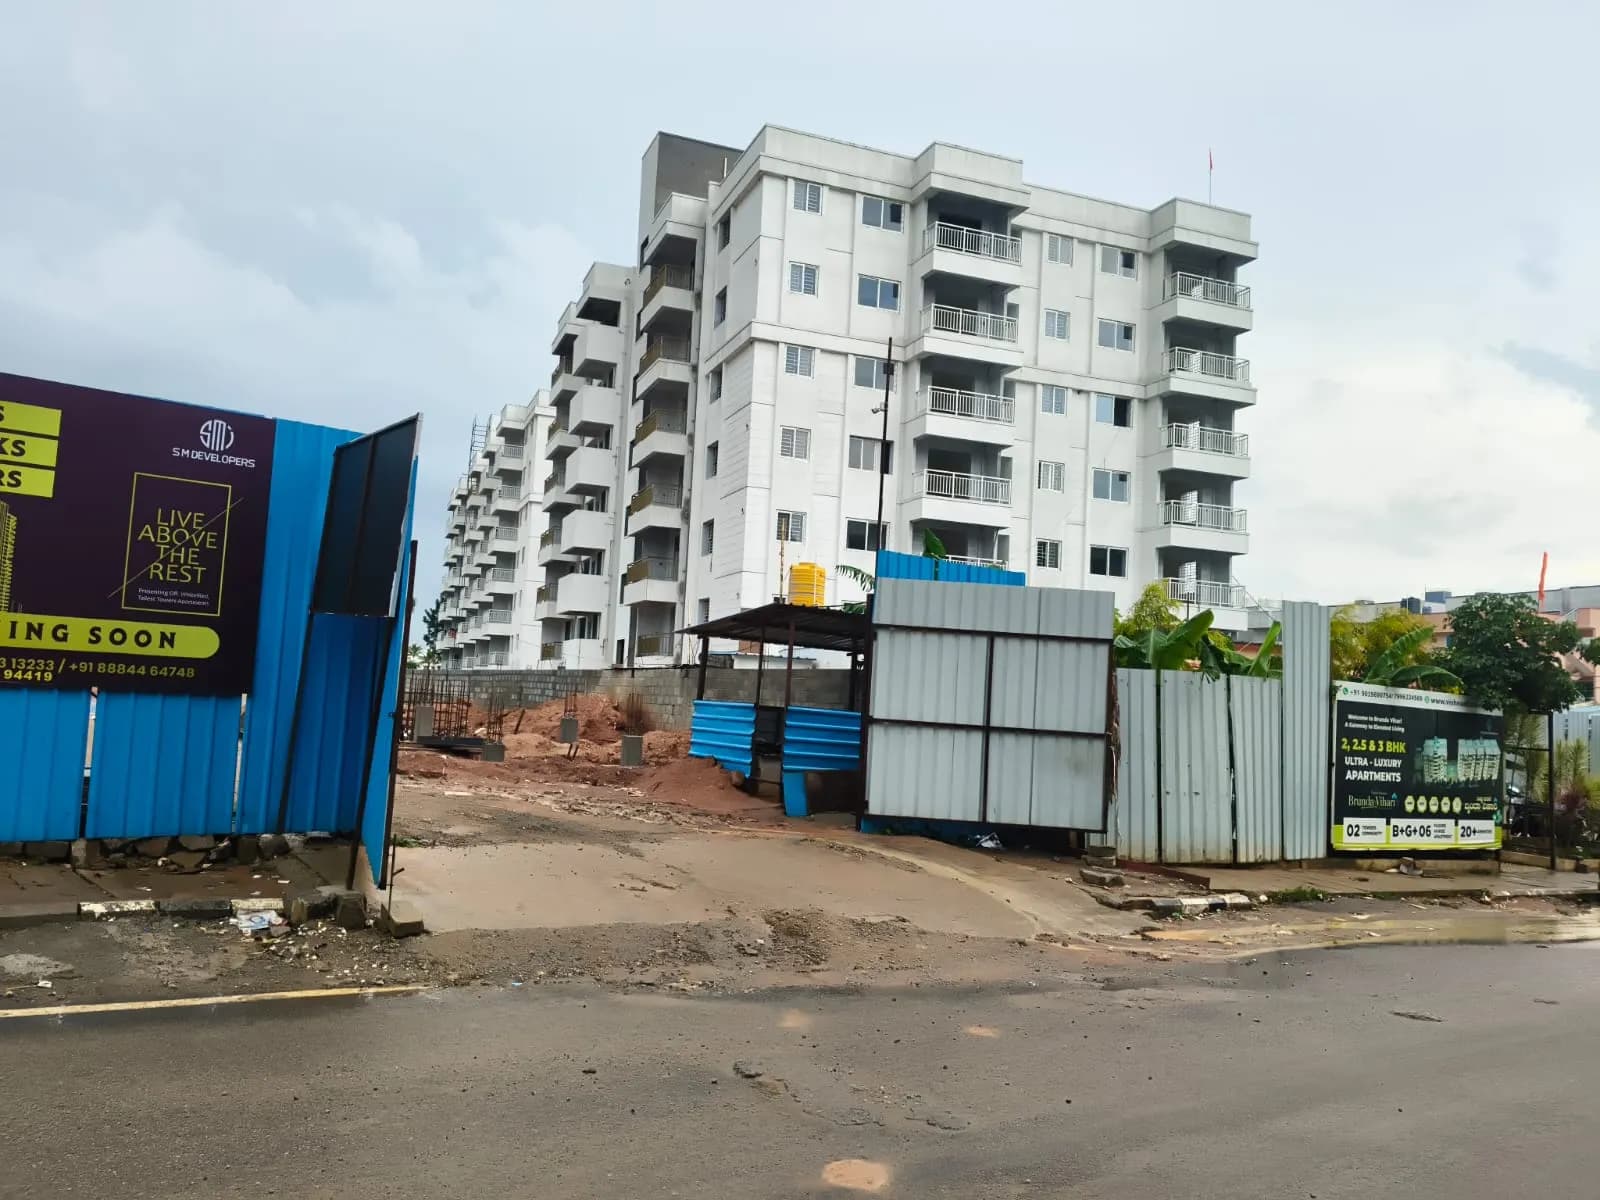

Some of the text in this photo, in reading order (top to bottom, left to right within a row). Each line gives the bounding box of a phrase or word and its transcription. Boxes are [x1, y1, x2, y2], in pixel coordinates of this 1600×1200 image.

[191, 450, 256, 468] DEVELOPERS
[156, 507, 205, 529] LIVE
[137, 524, 218, 549] ABOVE
[155, 544, 200, 565] THE
[149, 562, 207, 584] REST
[88, 626, 176, 649] SOON
[4, 669, 54, 682] 94419
[11, 658, 54, 671] 13233
[69, 661, 93, 673] +91
[97, 663, 146, 676] 88844
[150, 667, 195, 679] 64748
[1341, 737, 1406, 753] 2, 2.5 & 3 BHK
[1344, 756, 1368, 767] ULTRA
[1374, 757, 1402, 768] LUXURY
[1345, 769, 1402, 782] APARTMENTS
[1346, 824, 1361, 837] 02
